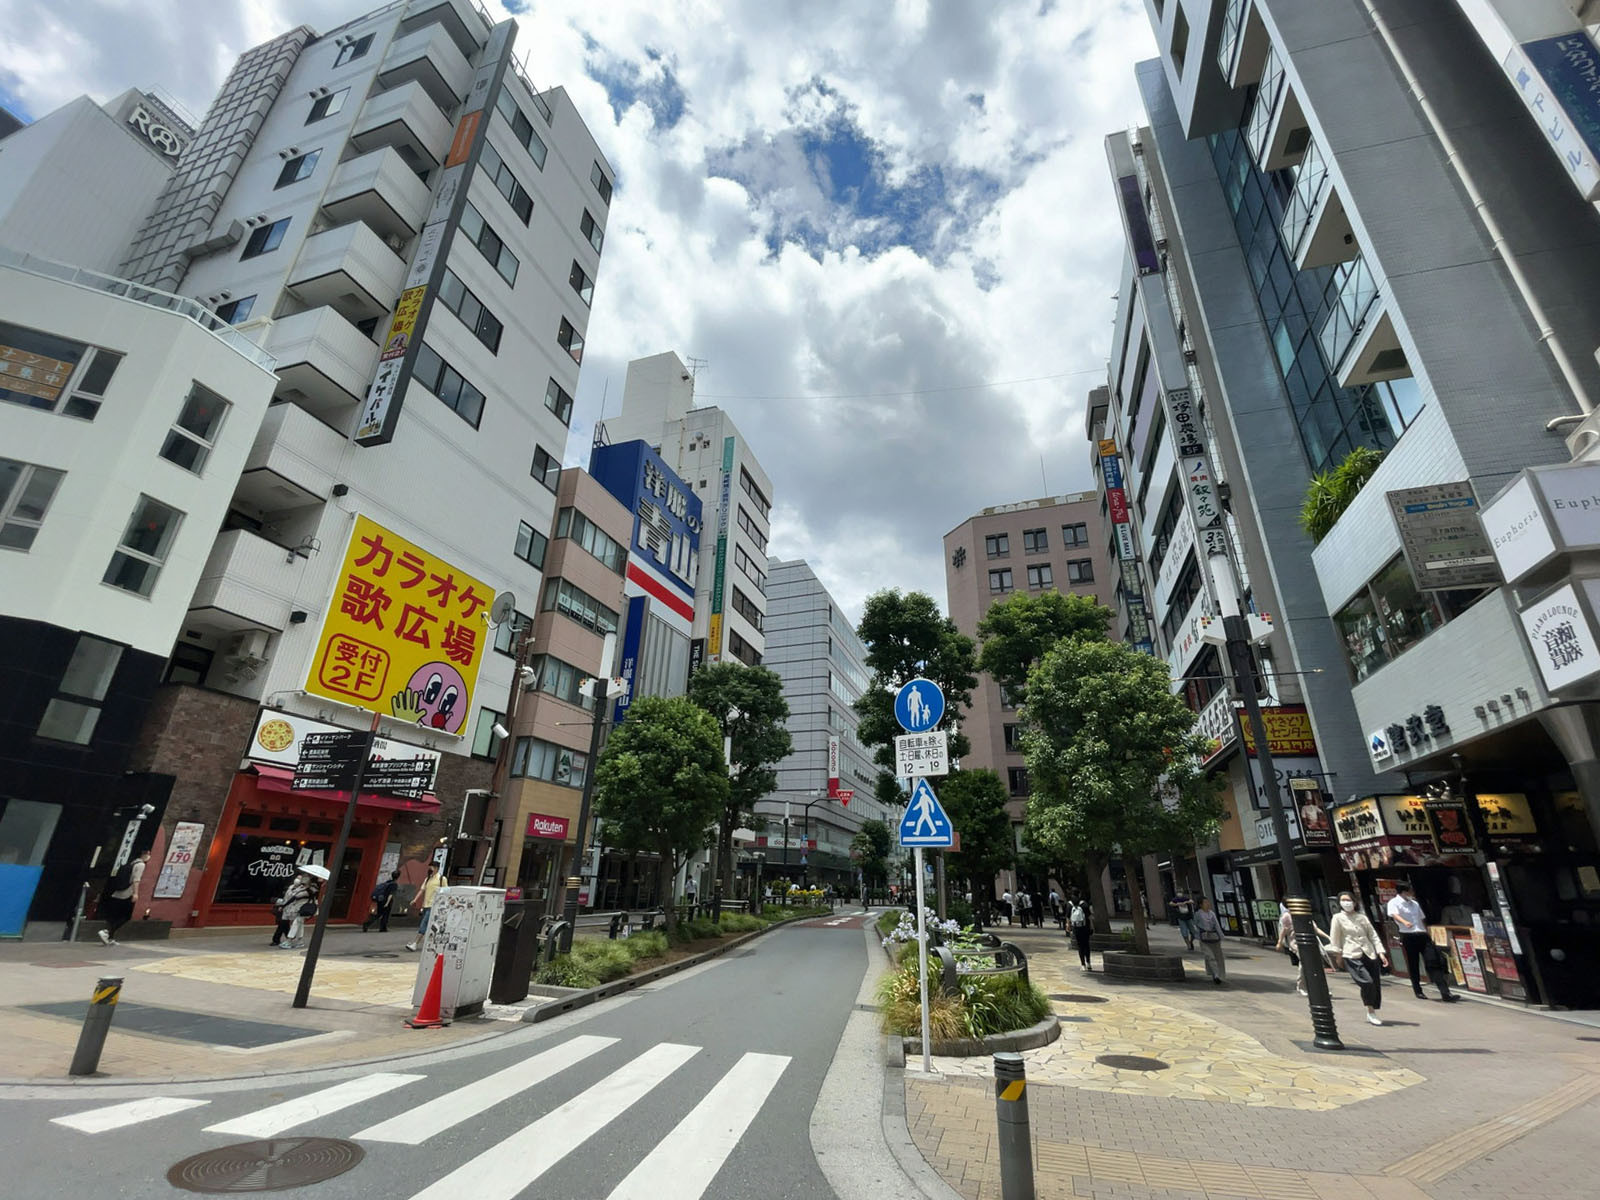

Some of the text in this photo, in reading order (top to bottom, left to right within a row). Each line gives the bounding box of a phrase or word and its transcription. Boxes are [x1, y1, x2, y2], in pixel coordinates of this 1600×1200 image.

[403, 287, 424, 330] カラオケ
[644, 459, 702, 534] 洋服の
[637, 498, 699, 588] 青山
[1494, 510, 1538, 549] Euphoria
[354, 534, 486, 619] カラオケ
[340, 574, 477, 666] 歌広場
[1547, 605, 1578, 619] LOUNGE
[334, 640, 383, 672] 受付
[328, 665, 375, 691] 2F
[899, 736, 943, 749] 自転車を除く
[904, 762, 914, 774] 12
[533, 818, 564, 834] Rakuten
[773, 838, 797, 847] docmo
